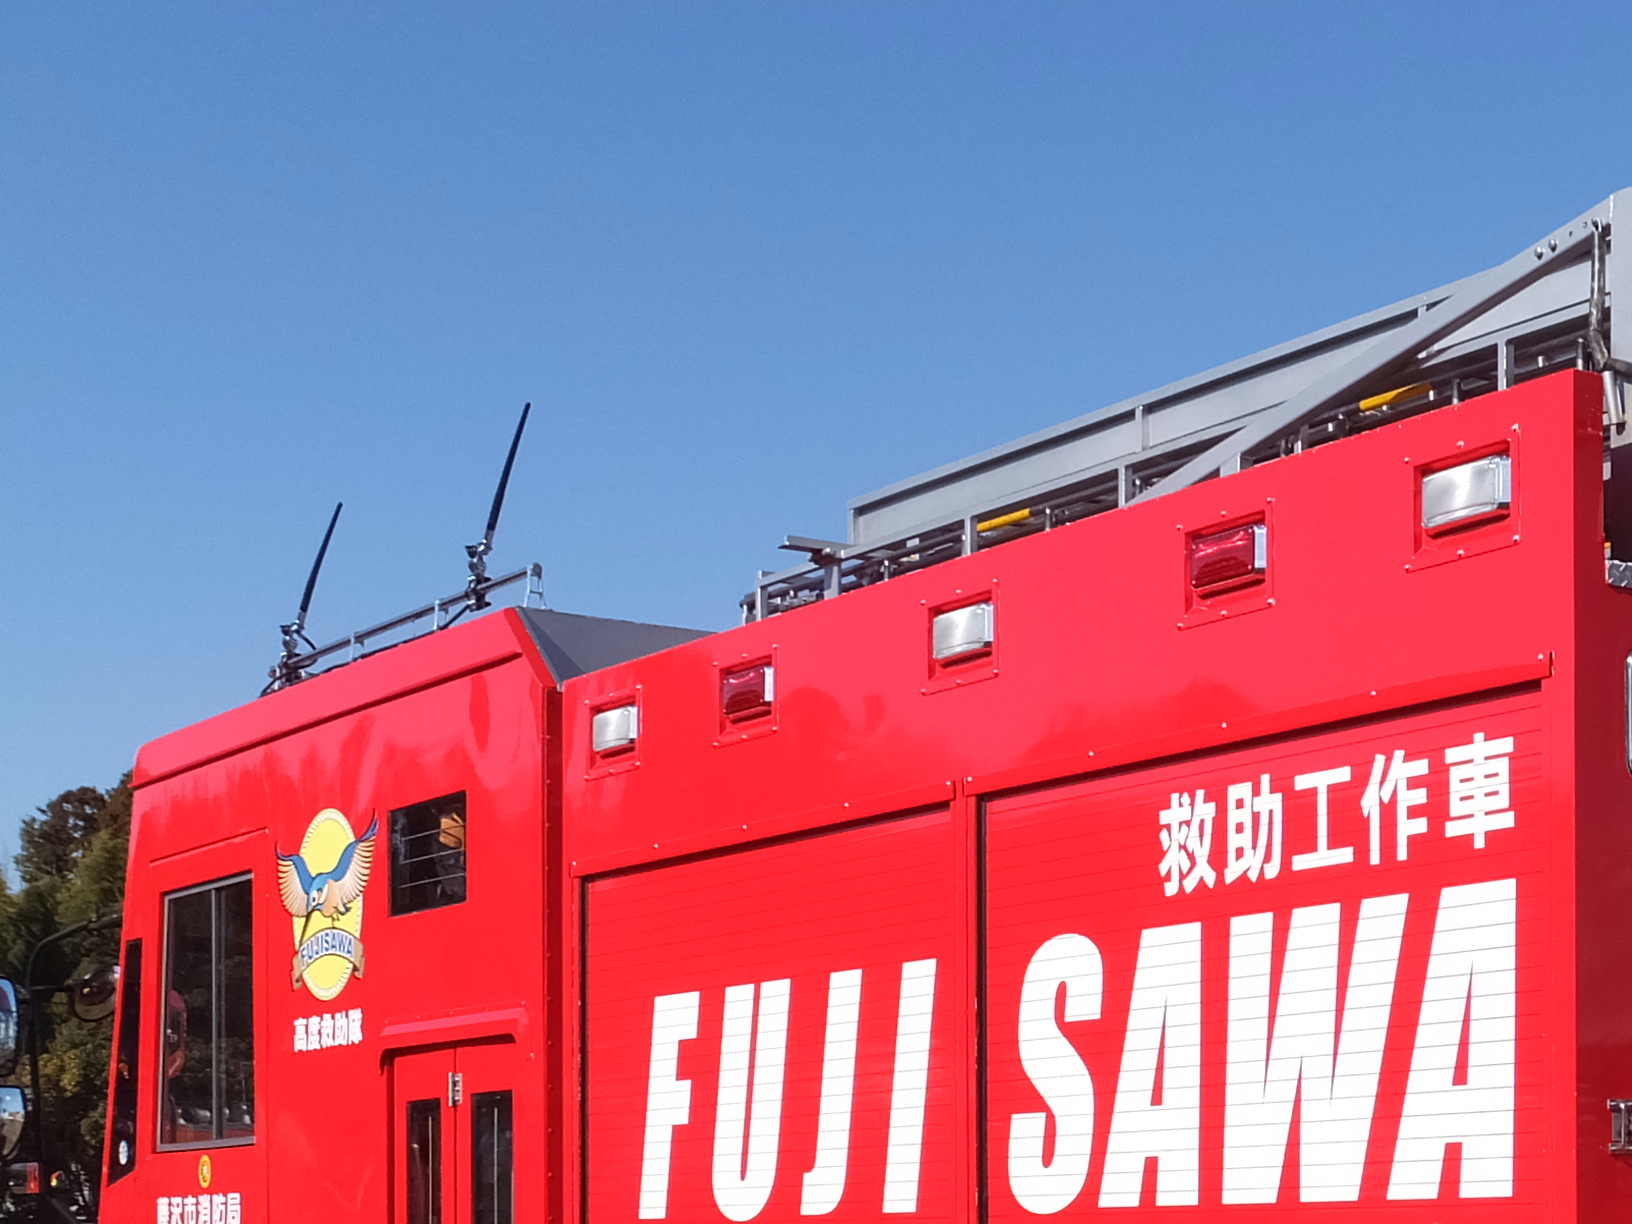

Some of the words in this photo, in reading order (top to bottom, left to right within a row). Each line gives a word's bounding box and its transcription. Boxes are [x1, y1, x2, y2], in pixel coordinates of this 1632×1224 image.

[1157, 731, 1516, 897] 救助工作車
[299, 931, 354, 967] FUJISAWA
[293, 1007, 363, 1053] 高度救助隊
[637, 957, 938, 1223] FUJI
[1007, 877, 1517, 1215] SAWA
